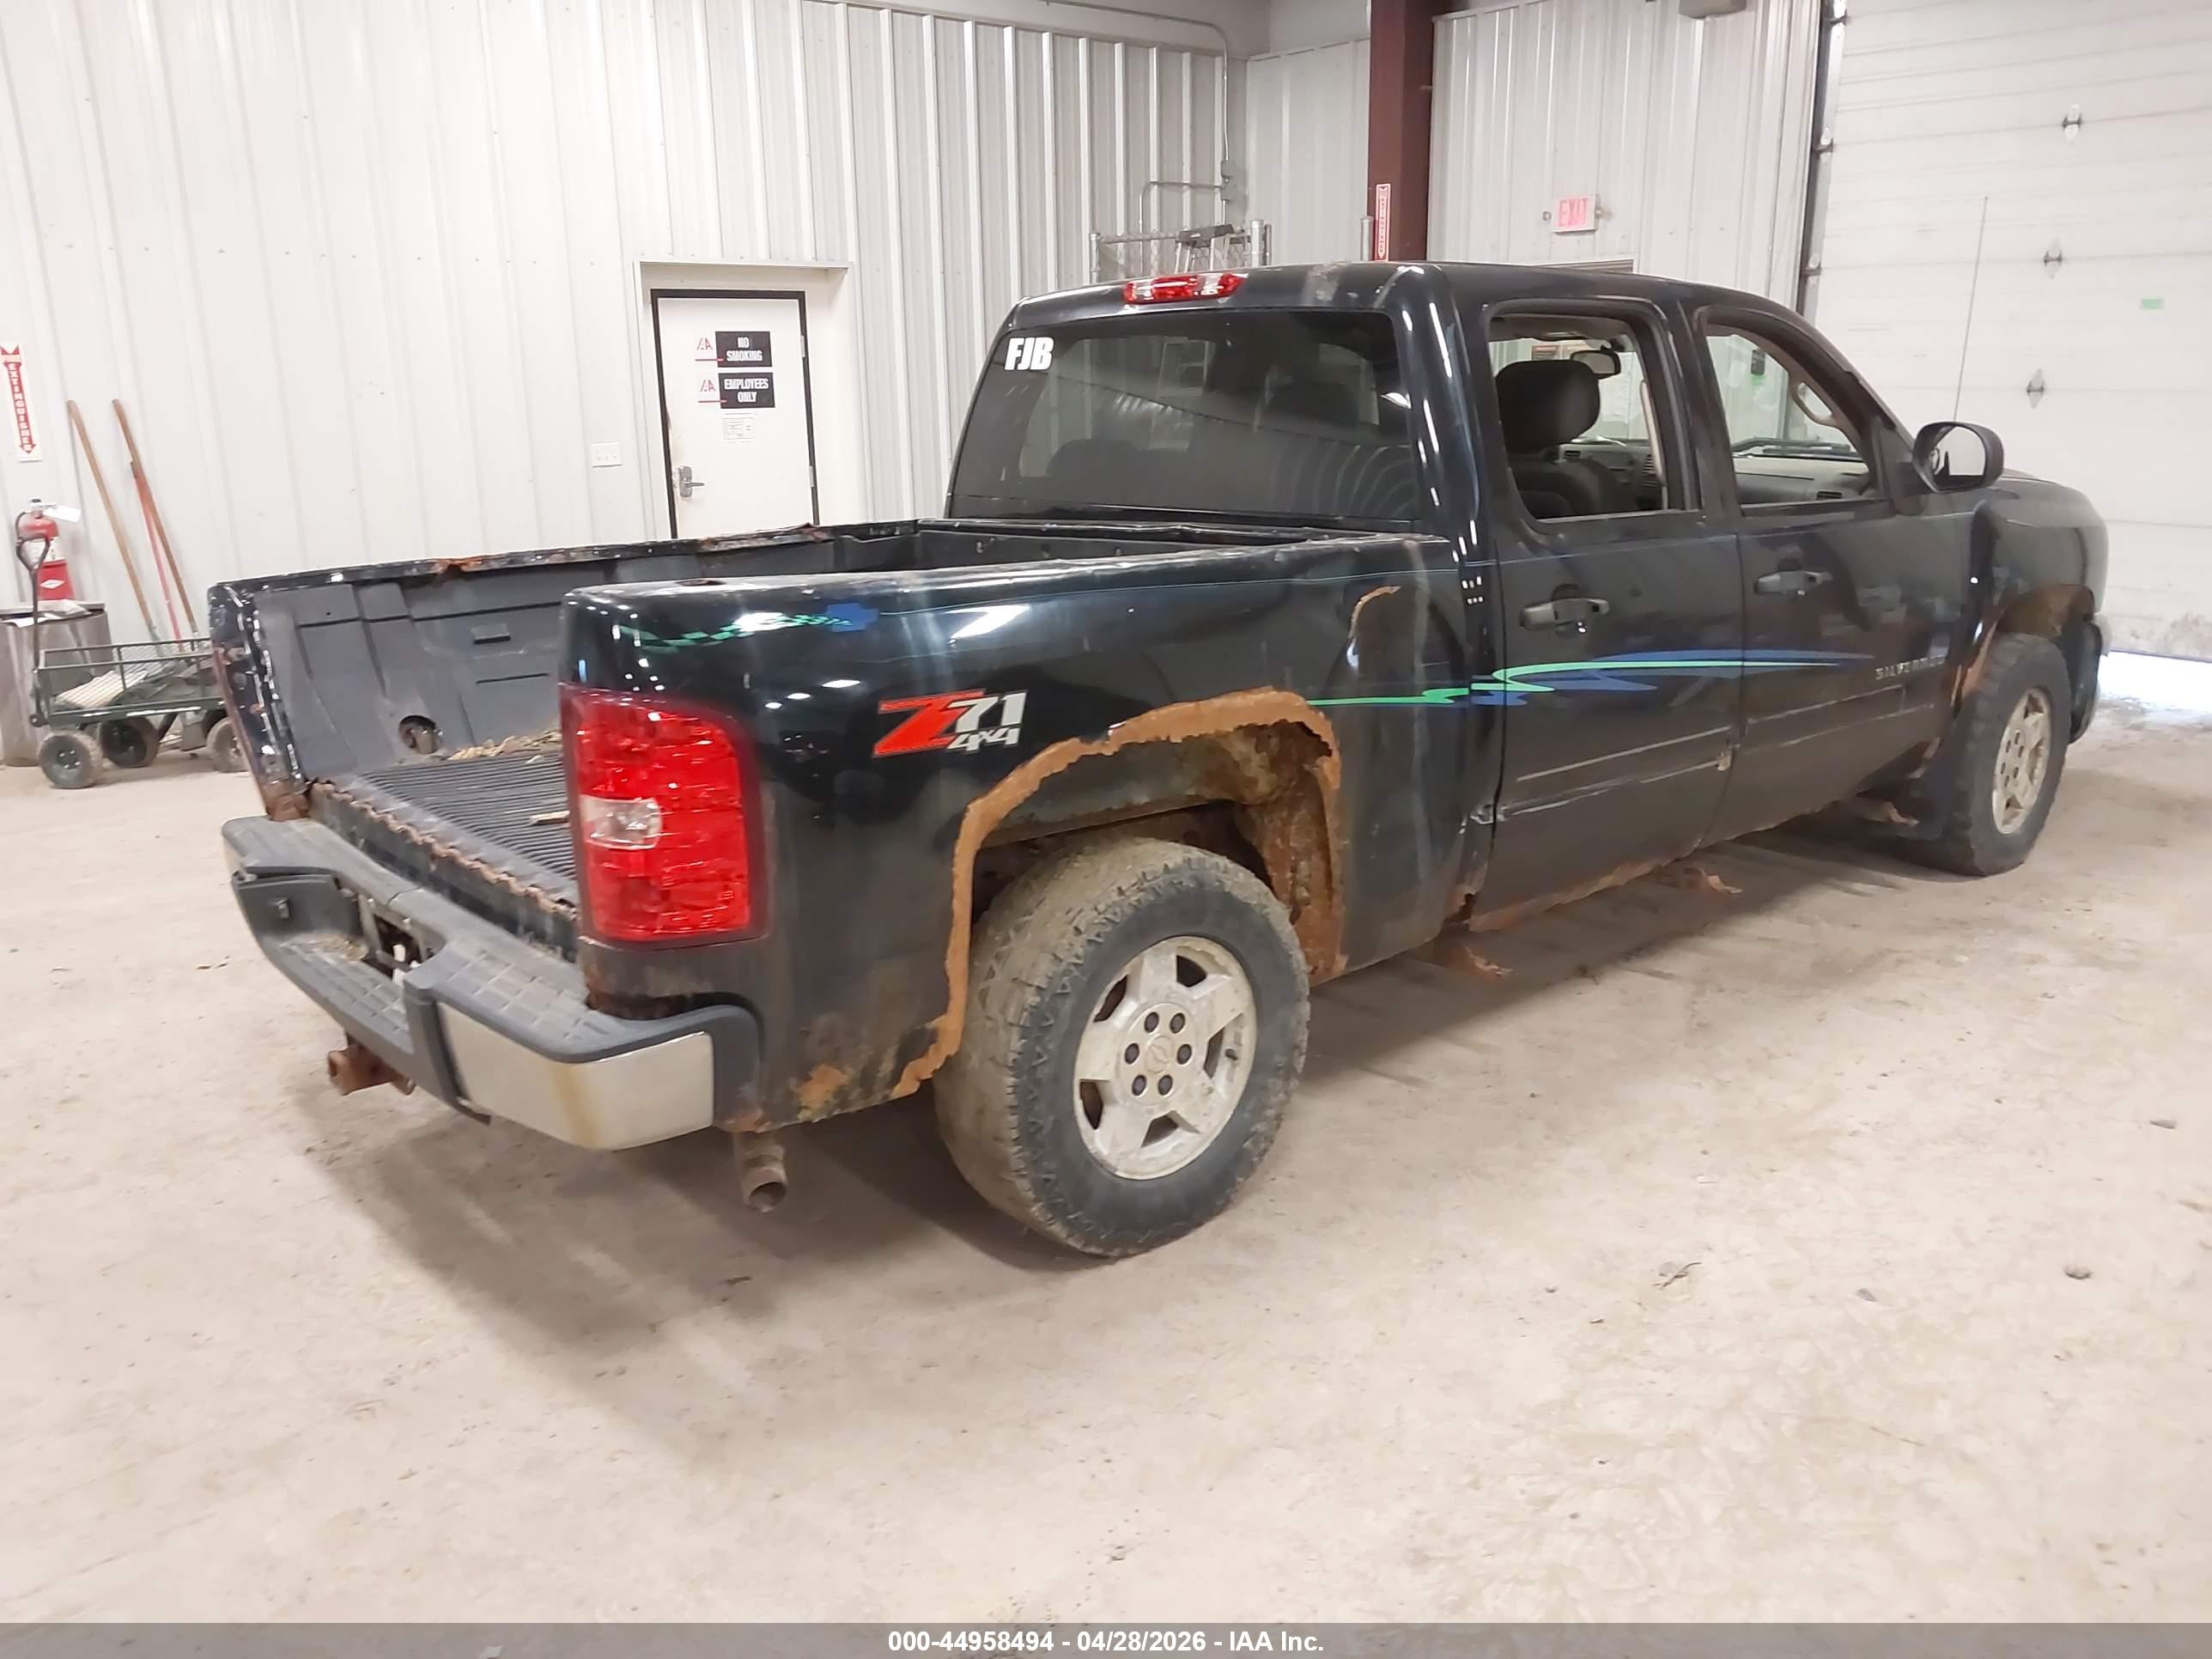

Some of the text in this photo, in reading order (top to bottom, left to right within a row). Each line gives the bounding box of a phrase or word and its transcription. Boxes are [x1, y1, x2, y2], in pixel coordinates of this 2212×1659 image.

[1559, 198, 1588, 227] EXIT
[737, 337, 750, 349] NO
[726, 349, 763, 362] SMOKING
[1004, 337, 1054, 371] FJB
[724, 378, 769, 390] EMPLOYEES
[8, 362, 33, 449] EXTINGUISHER
[737, 392, 757, 403] ONLY
[872, 688, 1027, 757] Z71
